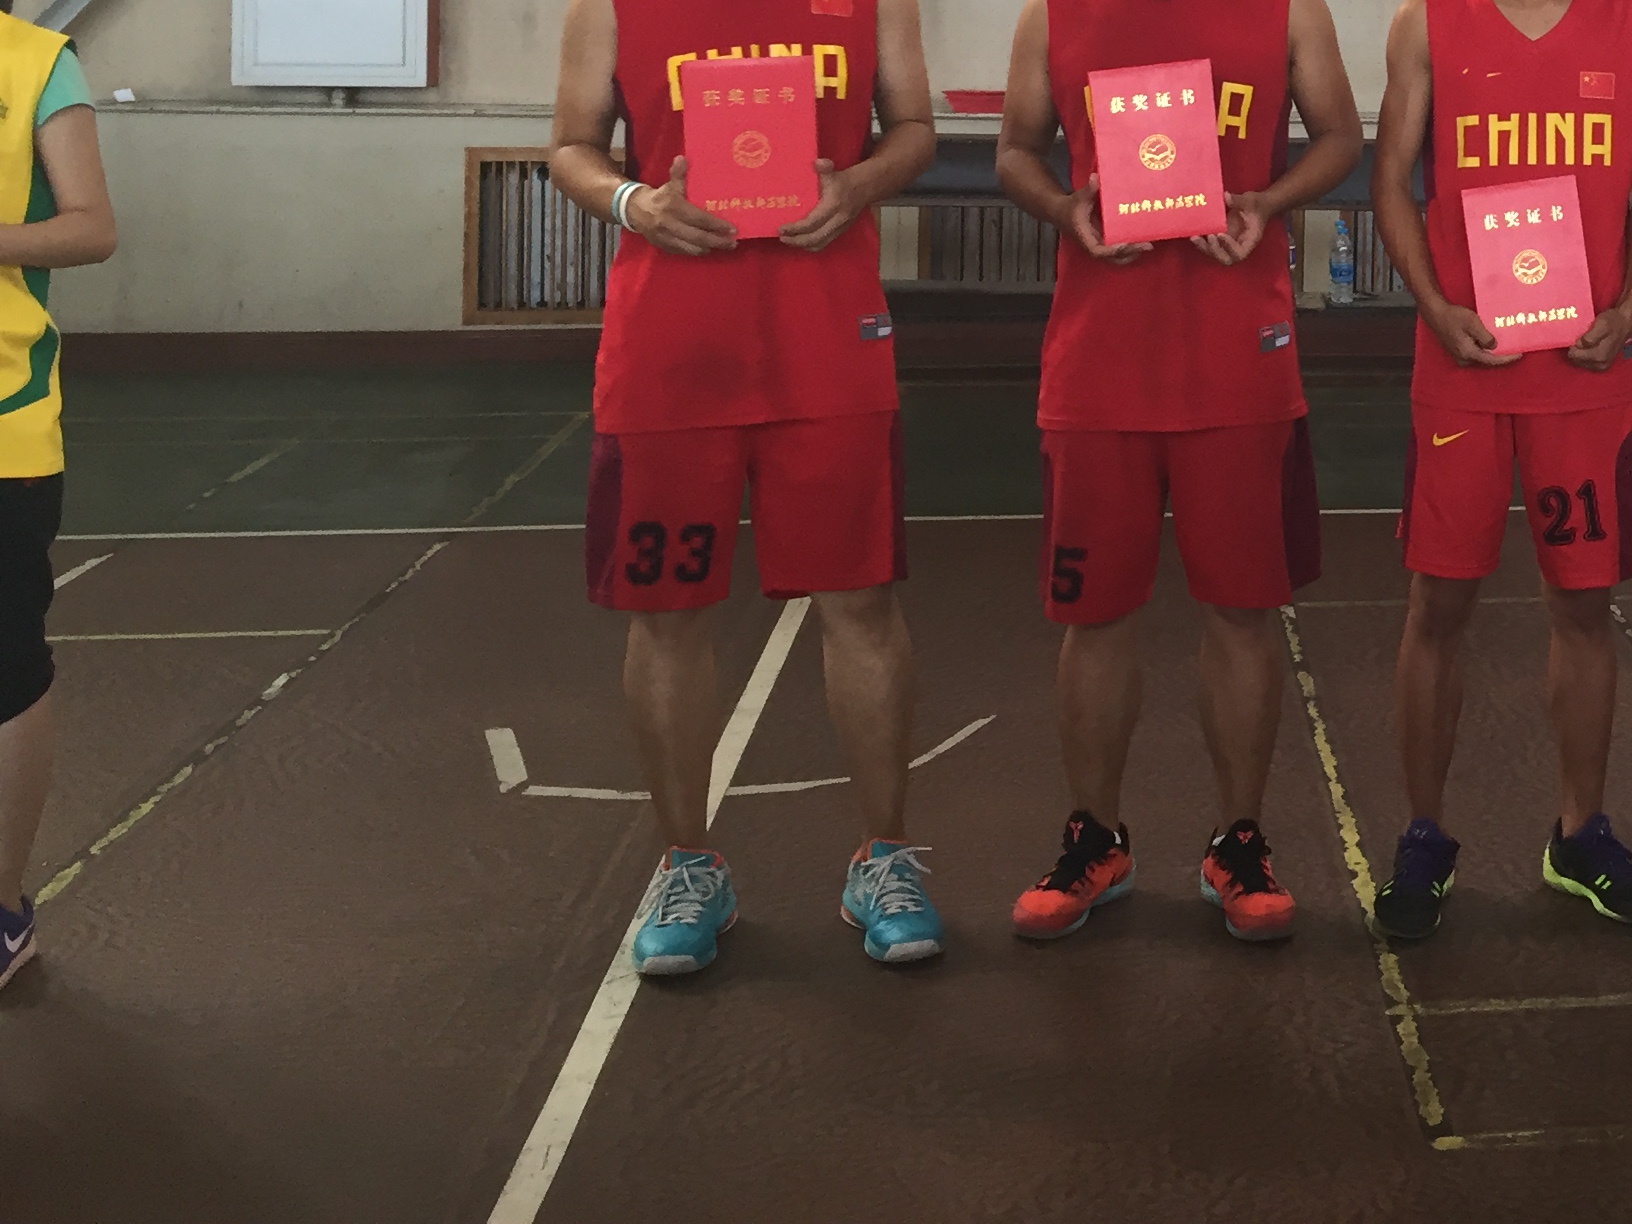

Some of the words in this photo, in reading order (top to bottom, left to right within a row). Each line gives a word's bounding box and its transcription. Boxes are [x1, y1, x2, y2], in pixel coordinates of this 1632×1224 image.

[1109, 88, 1196, 114] 获奖证书
[1456, 112, 1613, 168] CHINA
[1483, 204, 1564, 231] 获奖证书
[1536, 478, 1607, 547] 21
[624, 519, 717, 586] 33
[1049, 545, 1089, 604] 5
